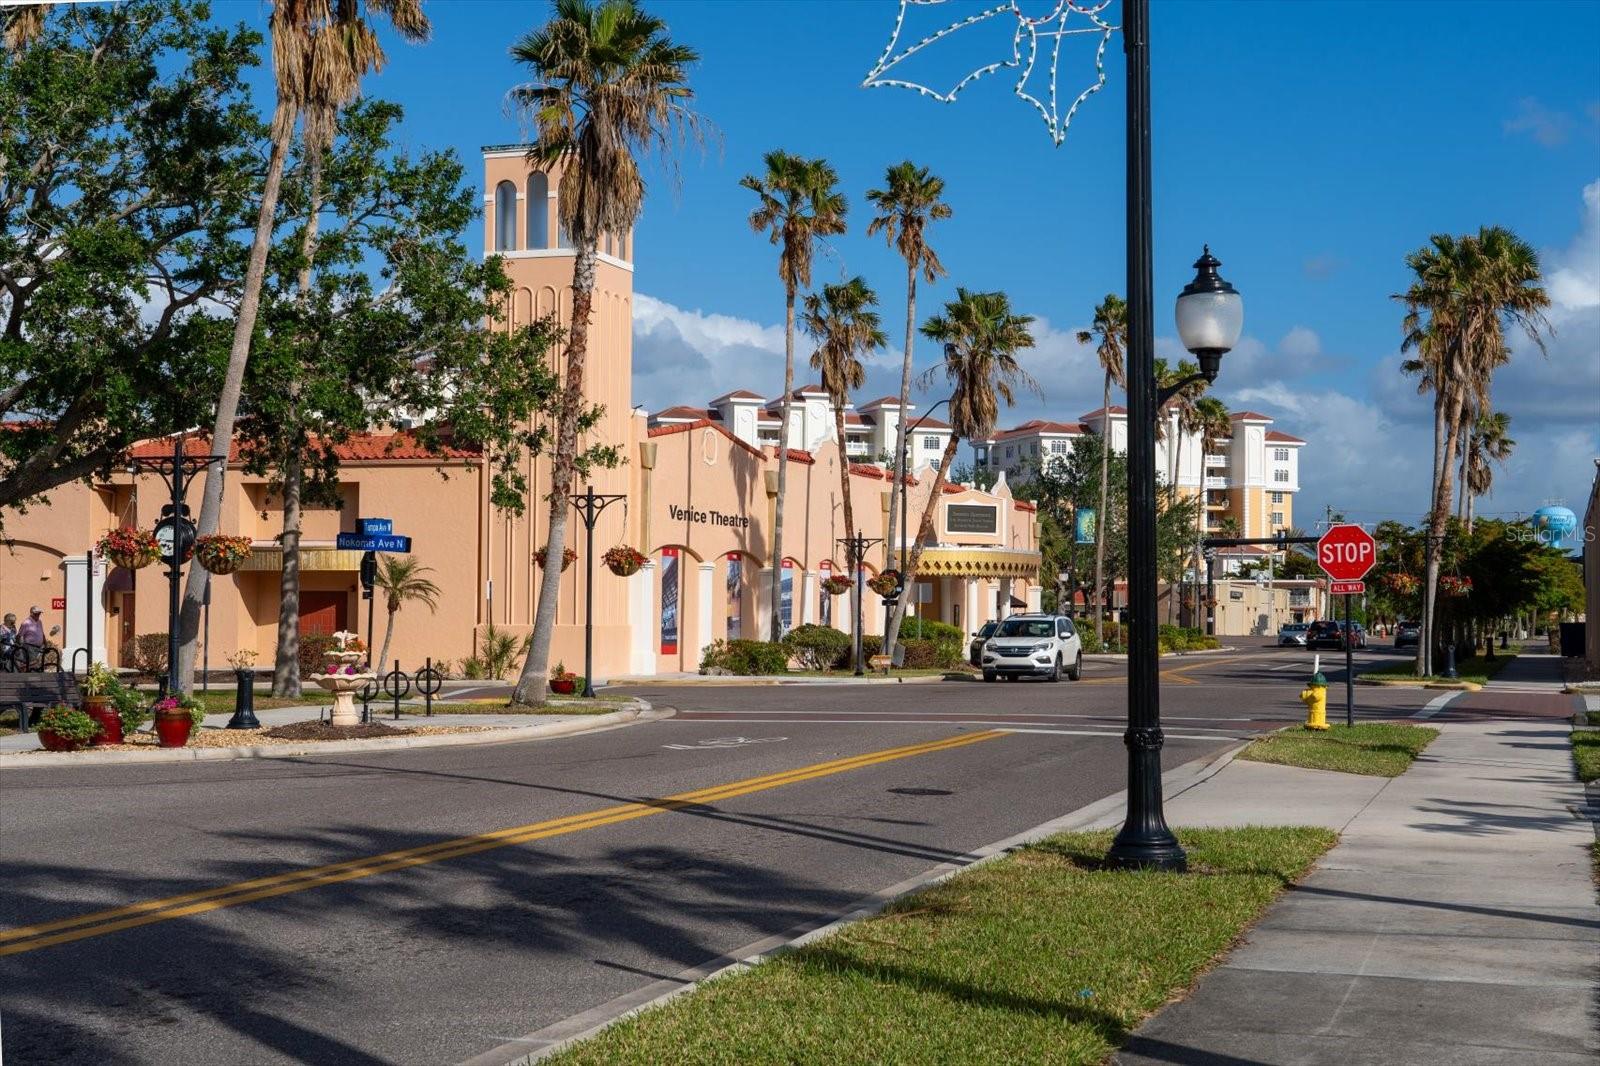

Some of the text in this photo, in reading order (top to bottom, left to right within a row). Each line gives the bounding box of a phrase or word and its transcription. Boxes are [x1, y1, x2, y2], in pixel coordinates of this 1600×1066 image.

[669, 504, 749, 528] Venice Theatre
[339, 537, 403, 548] Nokomis Ave N
[1322, 542, 1371, 564] STOP
[1333, 584, 1346, 592] ALL
[53, 600, 65, 608] FDC
